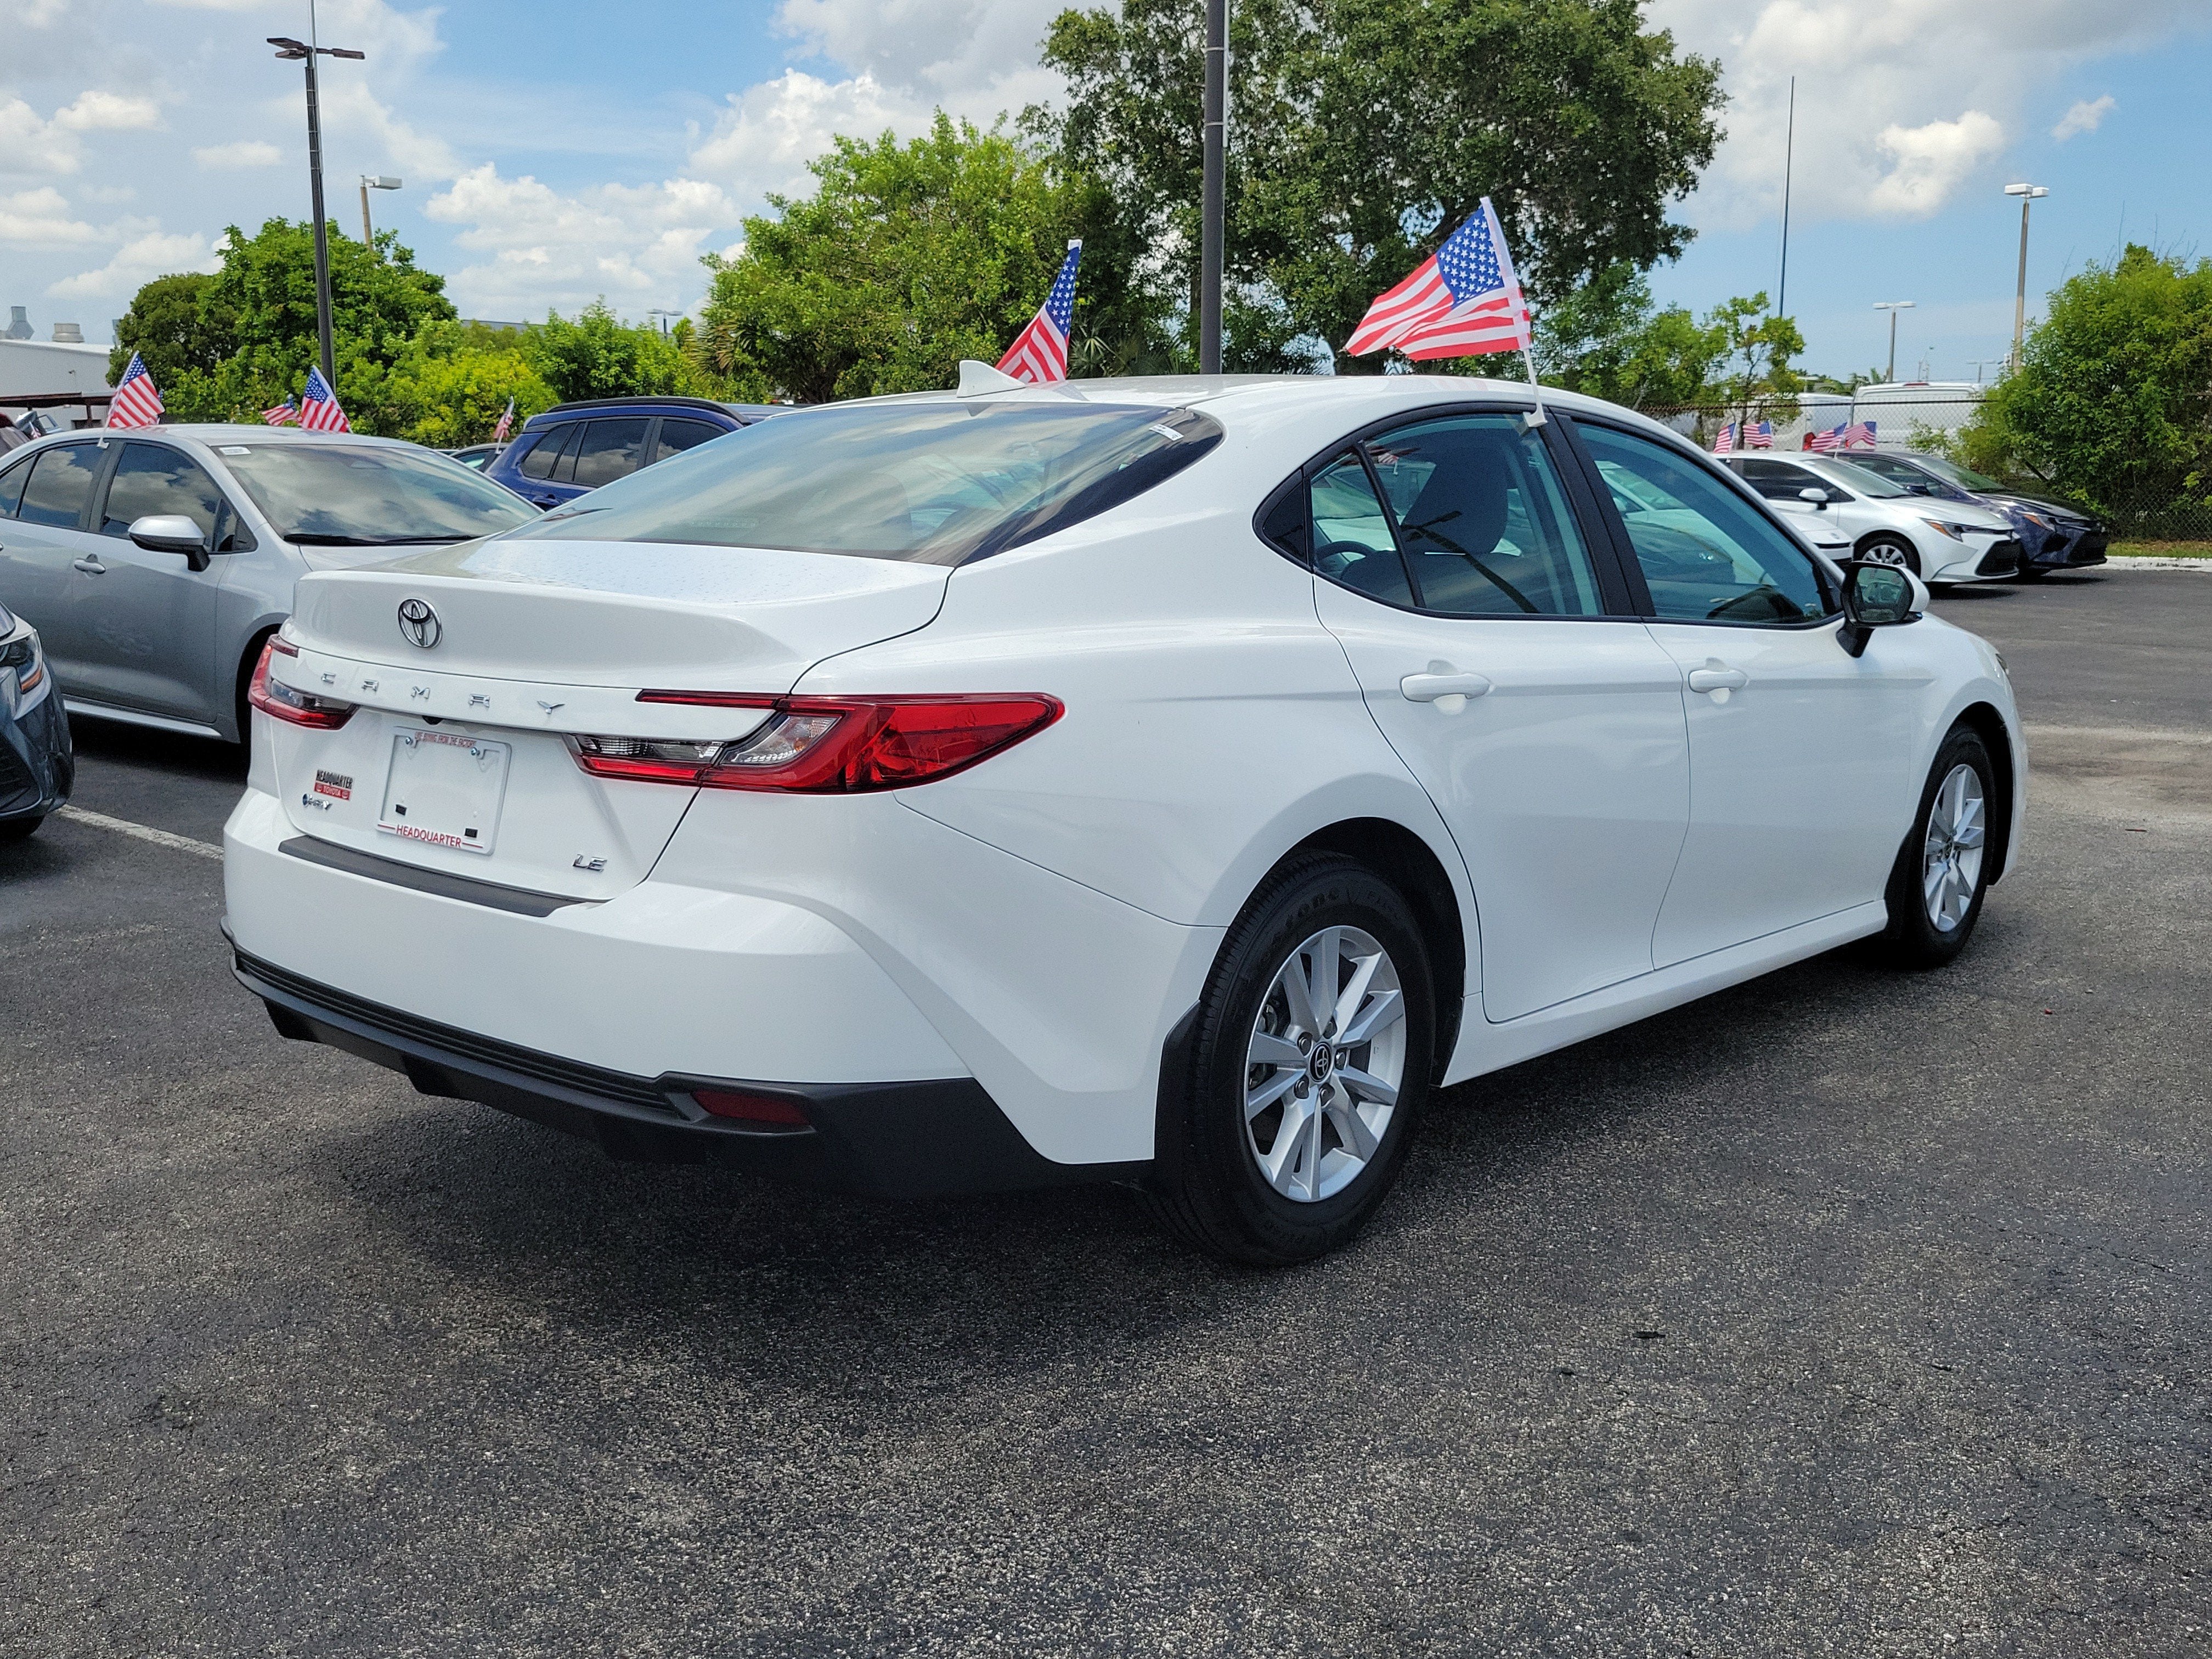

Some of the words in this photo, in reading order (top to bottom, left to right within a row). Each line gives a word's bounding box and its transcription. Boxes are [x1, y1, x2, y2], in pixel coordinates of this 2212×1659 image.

[321, 672, 565, 714] CAMRY
[316, 770, 353, 789] HEADQUARTER
[396, 824, 462, 848] HEADQUARTER
[572, 854, 607, 872] LE
